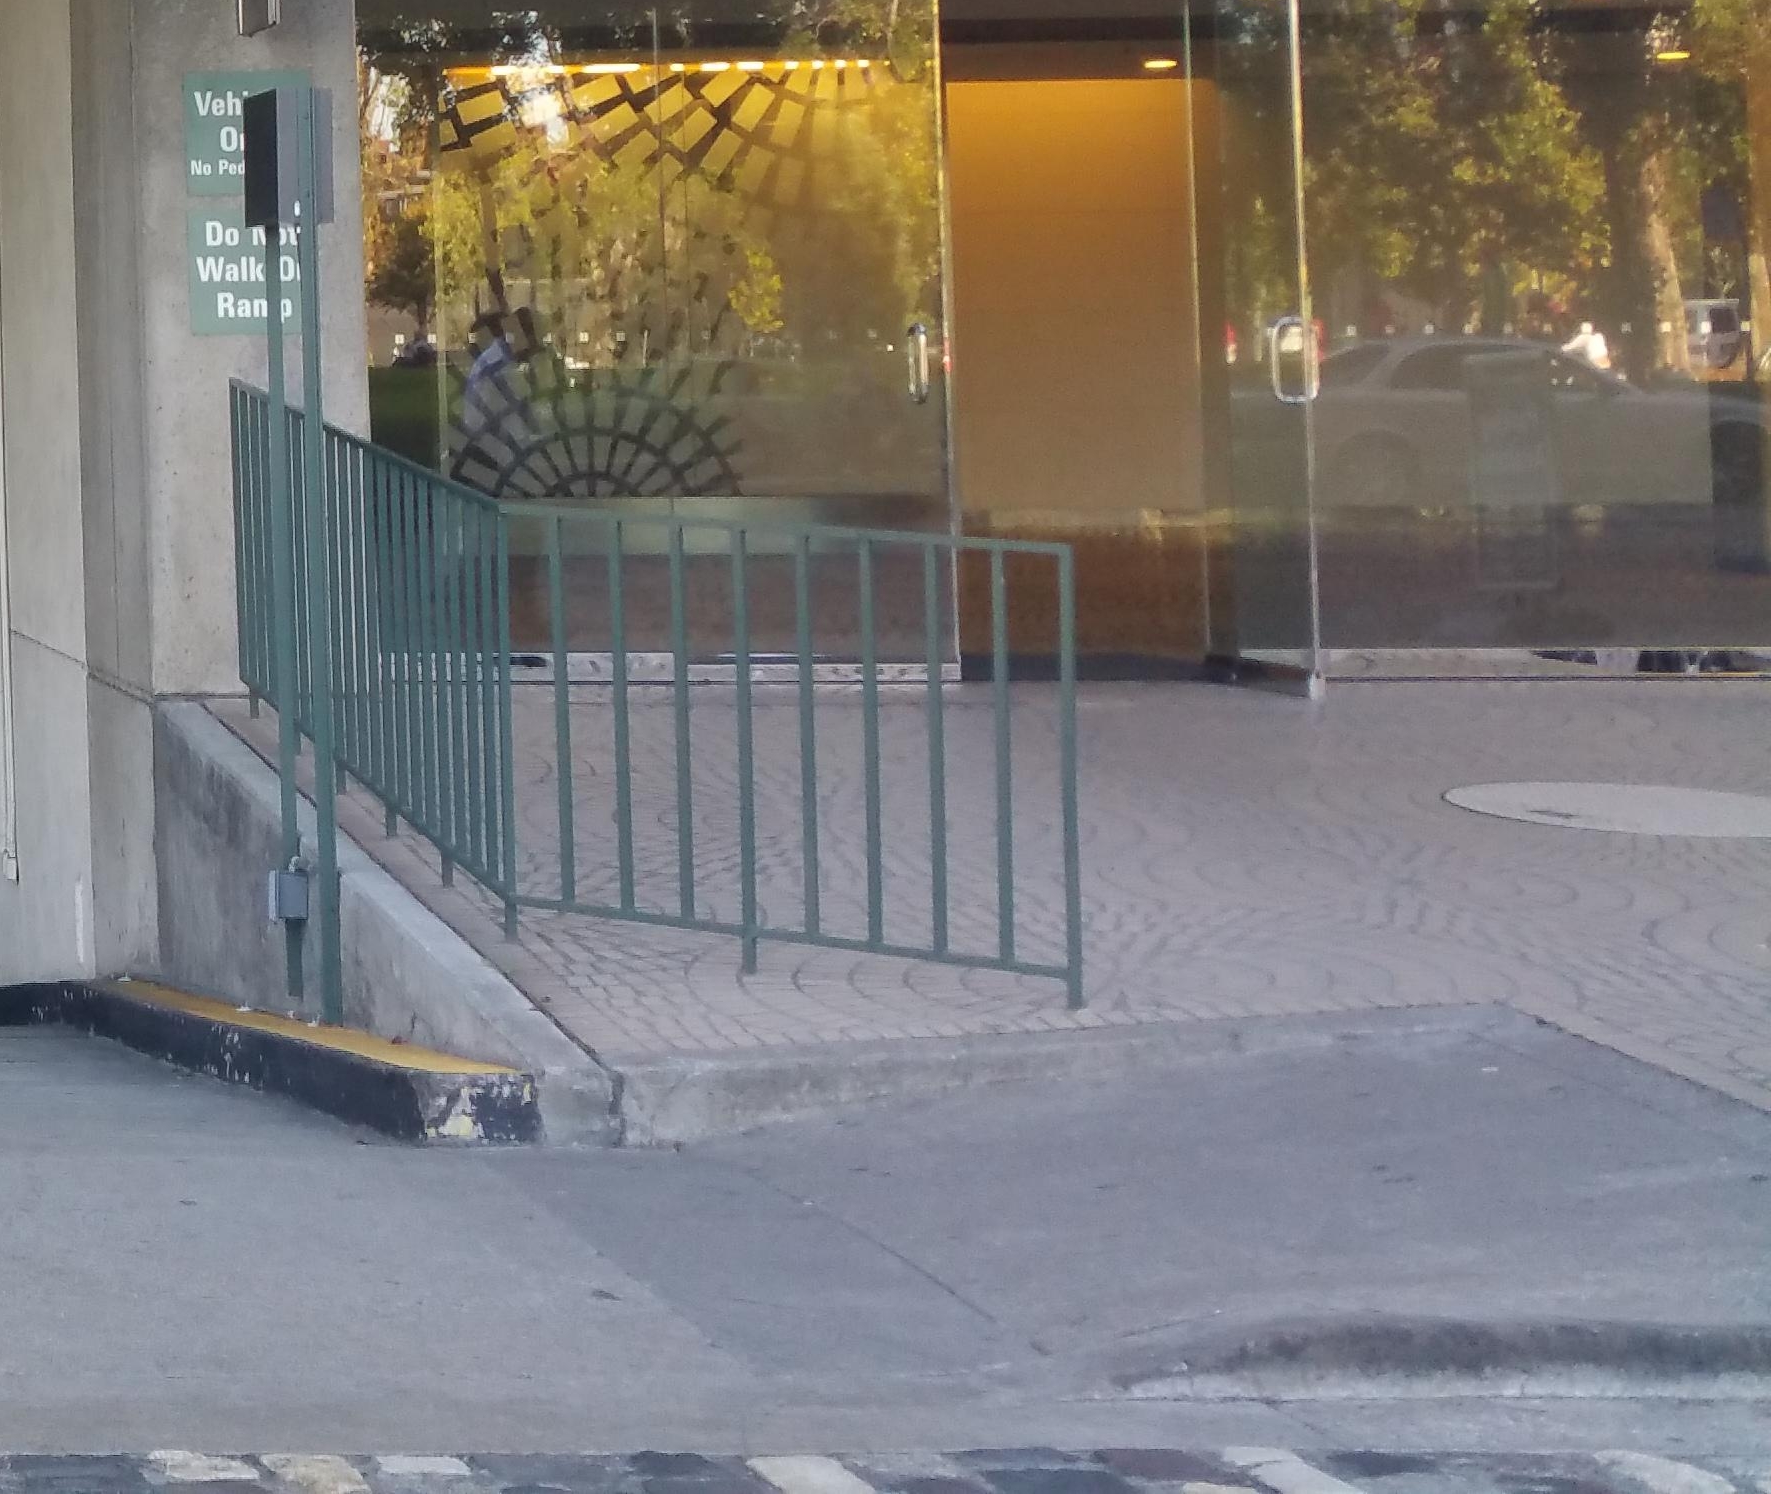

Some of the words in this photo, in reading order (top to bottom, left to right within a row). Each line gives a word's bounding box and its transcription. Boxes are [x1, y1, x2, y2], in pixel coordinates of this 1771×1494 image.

[190, 159, 212, 176] No
[205, 220, 240, 247] Do
[196, 256, 265, 283] Walk
